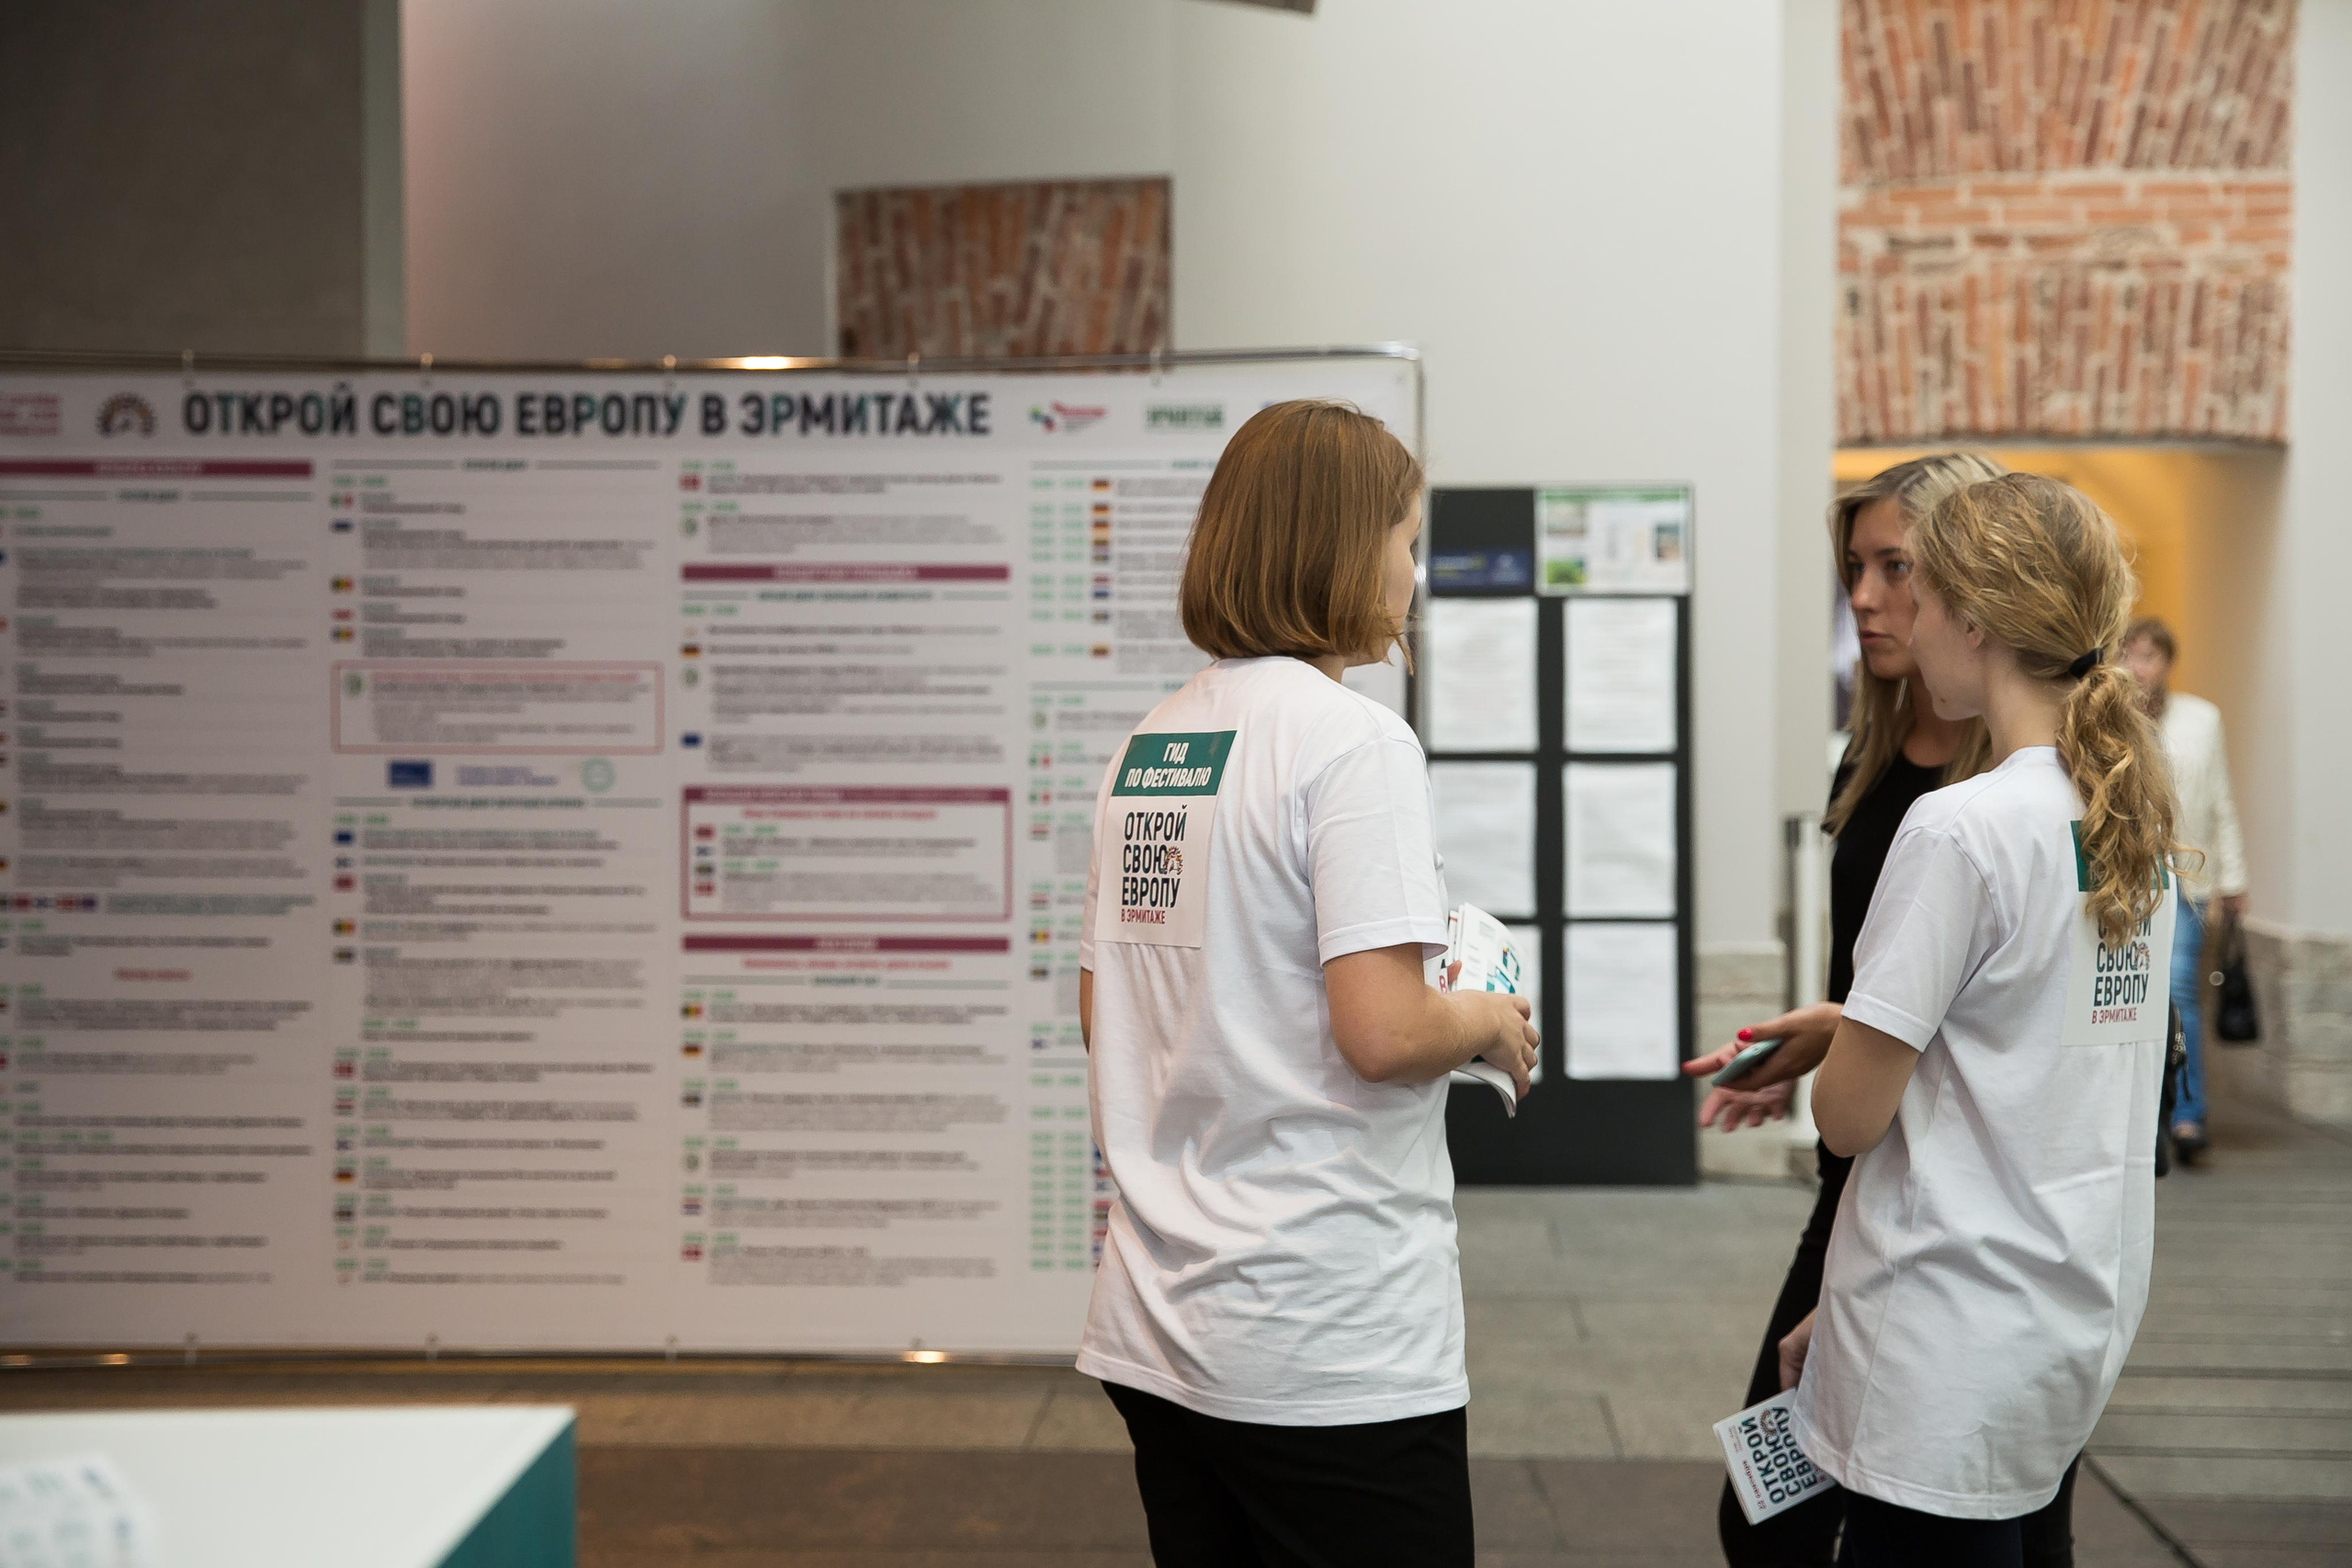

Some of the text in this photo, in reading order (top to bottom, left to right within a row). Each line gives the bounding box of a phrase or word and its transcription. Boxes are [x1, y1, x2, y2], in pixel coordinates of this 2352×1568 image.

[186, 381, 991, 436] ОТКРОЙ СВОЮ ЕВРОПУ В ЭРМИТАЖЕ
[1162, 742, 1190, 764] ГИД
[1125, 766, 1213, 789] ПО ФЕСТИВАЛЮ
[1124, 804, 1187, 841] ОТКРОЙ
[1123, 844, 1168, 874] СВОЮ
[1121, 877, 1181, 908] ЕВРОПУ
[1121, 908, 1166, 924] В ЭРМИТАЖЕ
[2094, 974, 2149, 1007] ЕВРОПУ
[2092, 1007, 2137, 1024] В ЭРМИТАЖЕ
[1738, 1416, 1786, 1505] ОТКРОЙ
[1764, 1430, 1803, 1496] СВОЮ
